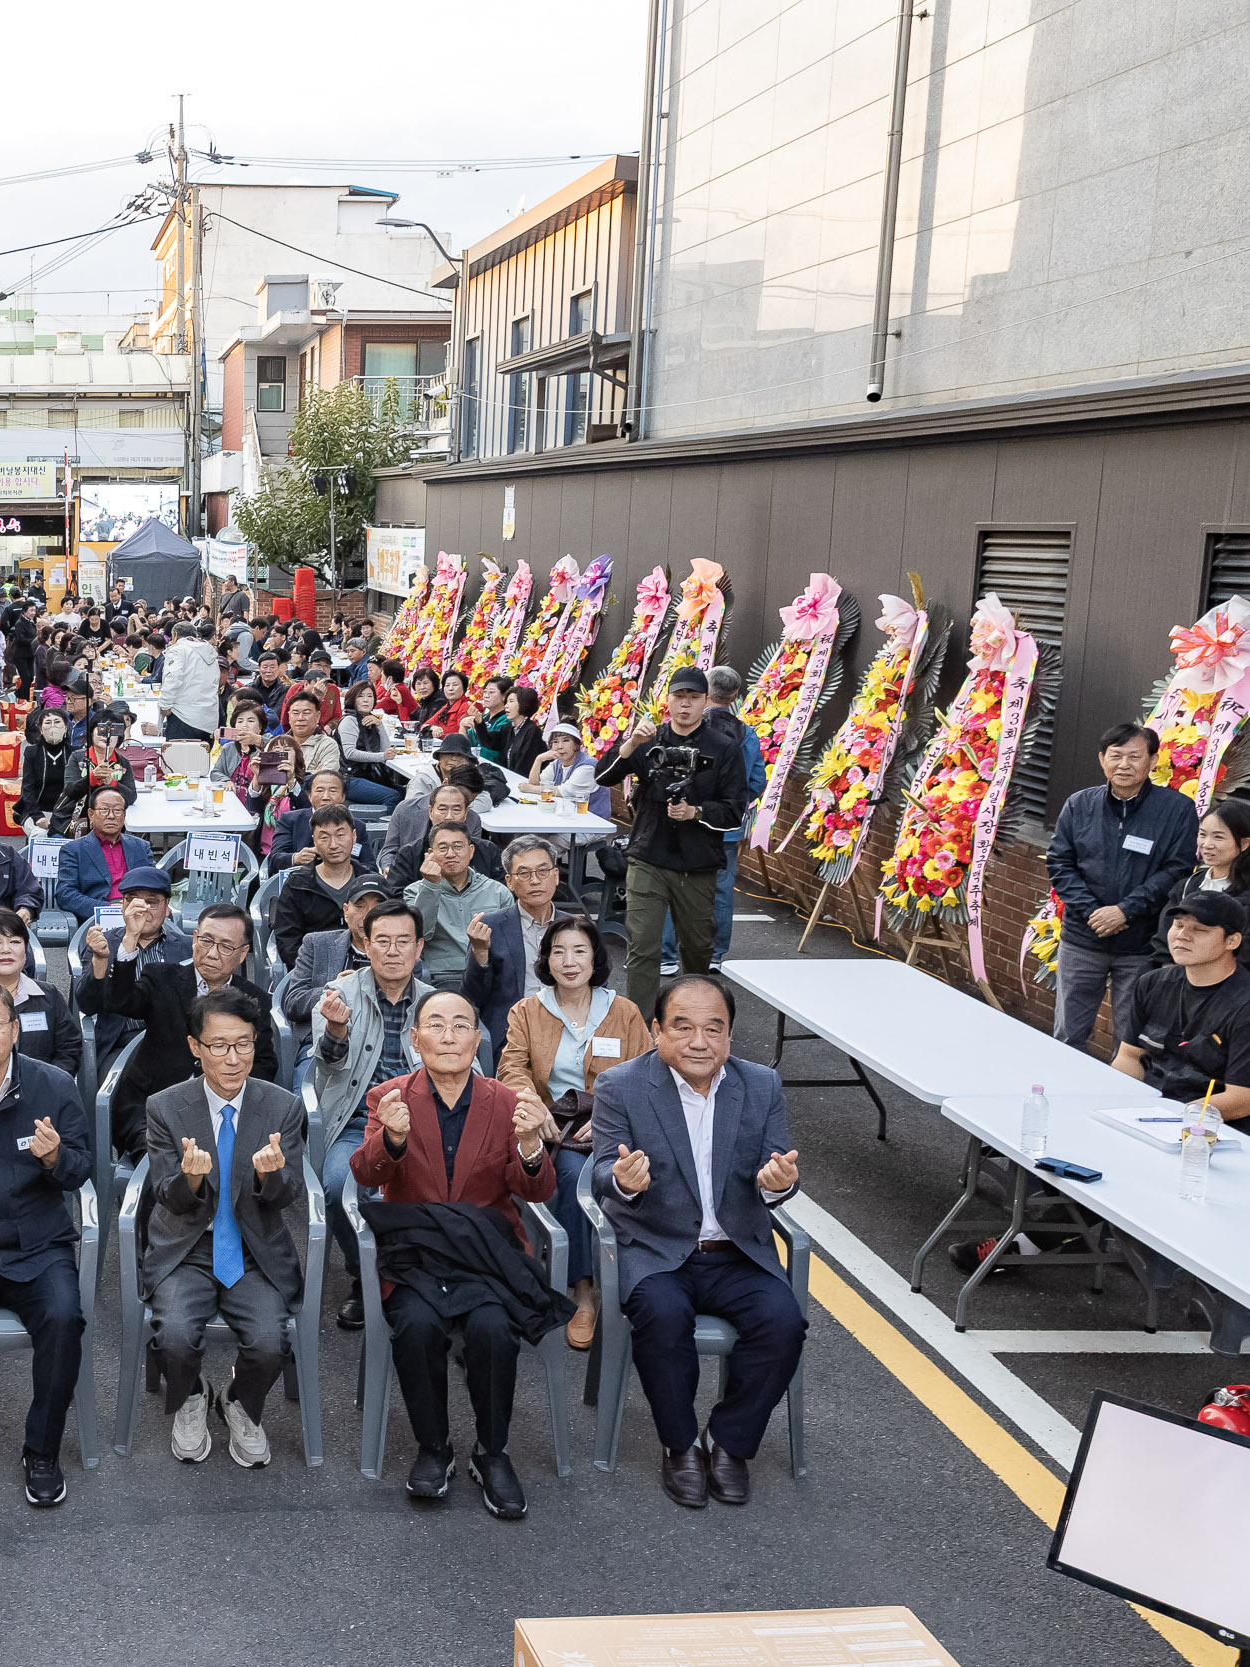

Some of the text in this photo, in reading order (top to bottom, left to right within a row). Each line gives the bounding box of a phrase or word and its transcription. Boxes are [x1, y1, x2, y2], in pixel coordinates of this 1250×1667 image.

[14, 476, 39, 487] 합시다
[818, 633, 834, 645] 祝
[701, 641, 714, 673] 제3
[809, 649, 829, 680] 제3회
[1010, 675, 1028, 691] 축
[1004, 696, 1024, 741] 제3회
[37, 855, 59, 867] 내빈
